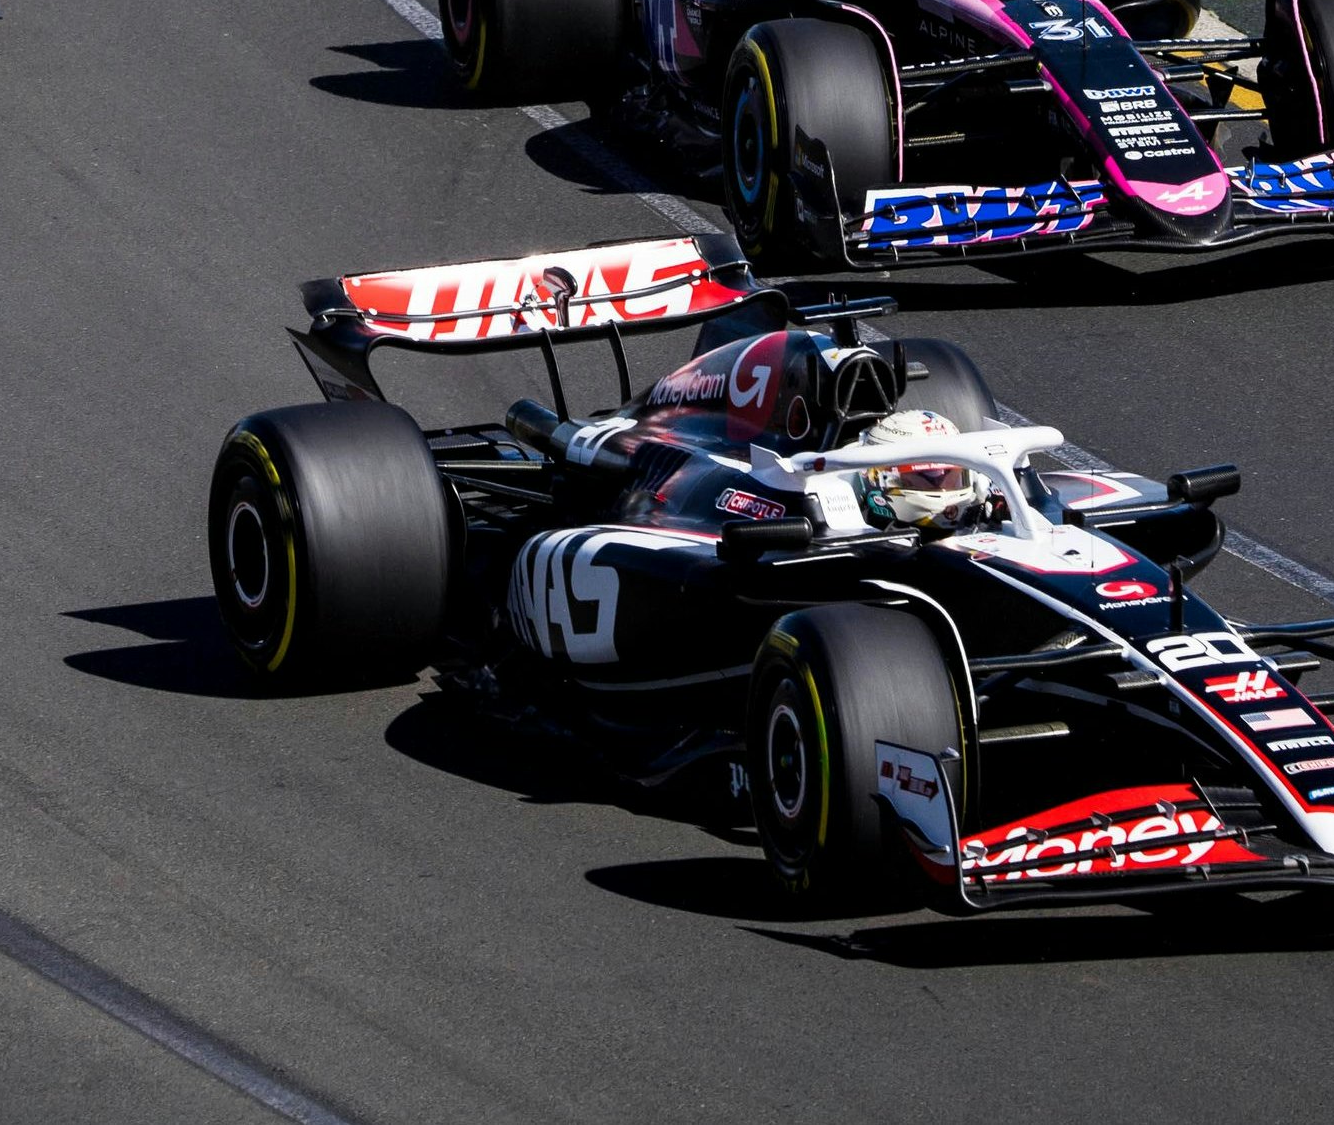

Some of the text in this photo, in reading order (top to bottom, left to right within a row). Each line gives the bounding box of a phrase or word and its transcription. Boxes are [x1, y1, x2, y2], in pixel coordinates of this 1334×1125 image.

[919, 19, 976, 54] ALPINE
[1028, 17, 1113, 42] 31
[1108, 85, 1156, 98] BWT
[1100, 110, 1172, 123] MOBILIZE
[1120, 99, 1157, 111] BRB
[1107, 122, 1181, 137] PIRELLI
[1144, 146, 1196, 158] Castrol
[861, 180, 1109, 249] BWT
[646, 368, 726, 411] MoneyGram
[730, 496, 780, 520] CHIPOTLE
[1146, 632, 1261, 673] 20
[1267, 735, 1334, 752] PIRELLI
[962, 812, 1223, 880] Money
